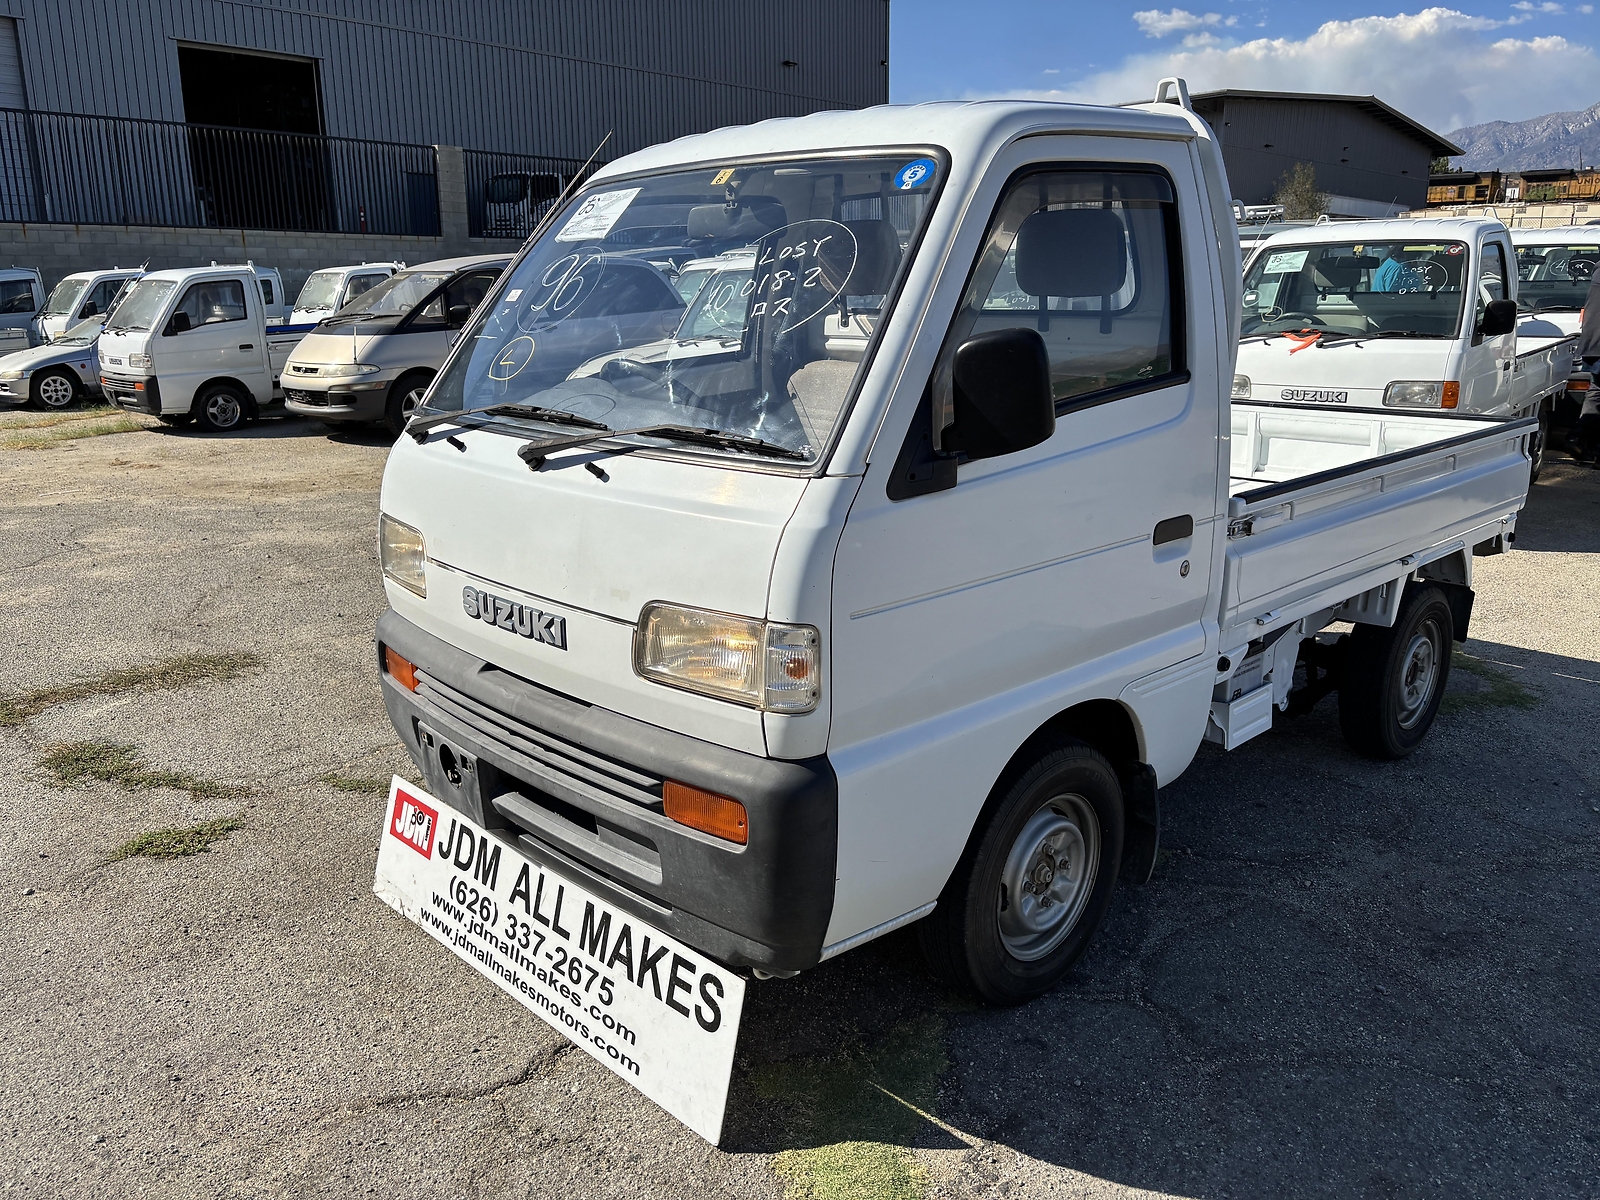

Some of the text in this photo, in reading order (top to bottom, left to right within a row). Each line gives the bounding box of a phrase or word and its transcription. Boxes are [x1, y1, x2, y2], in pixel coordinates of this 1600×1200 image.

[908, 170, 919, 179] 5
[530, 253, 601, 312] 96
[1281, 389, 1348, 403] SUZUKI
[462, 585, 567, 651] SUZUKI
[395, 800, 433, 852] JDM
[437, 819, 725, 1034] JDM ALL MAKES
[449, 875, 615, 1007] (626) 337-2675
[420, 907, 641, 1076] www.jdmallmakesmotors.com
[432, 891, 637, 1046] www.jdmallmakes.com
